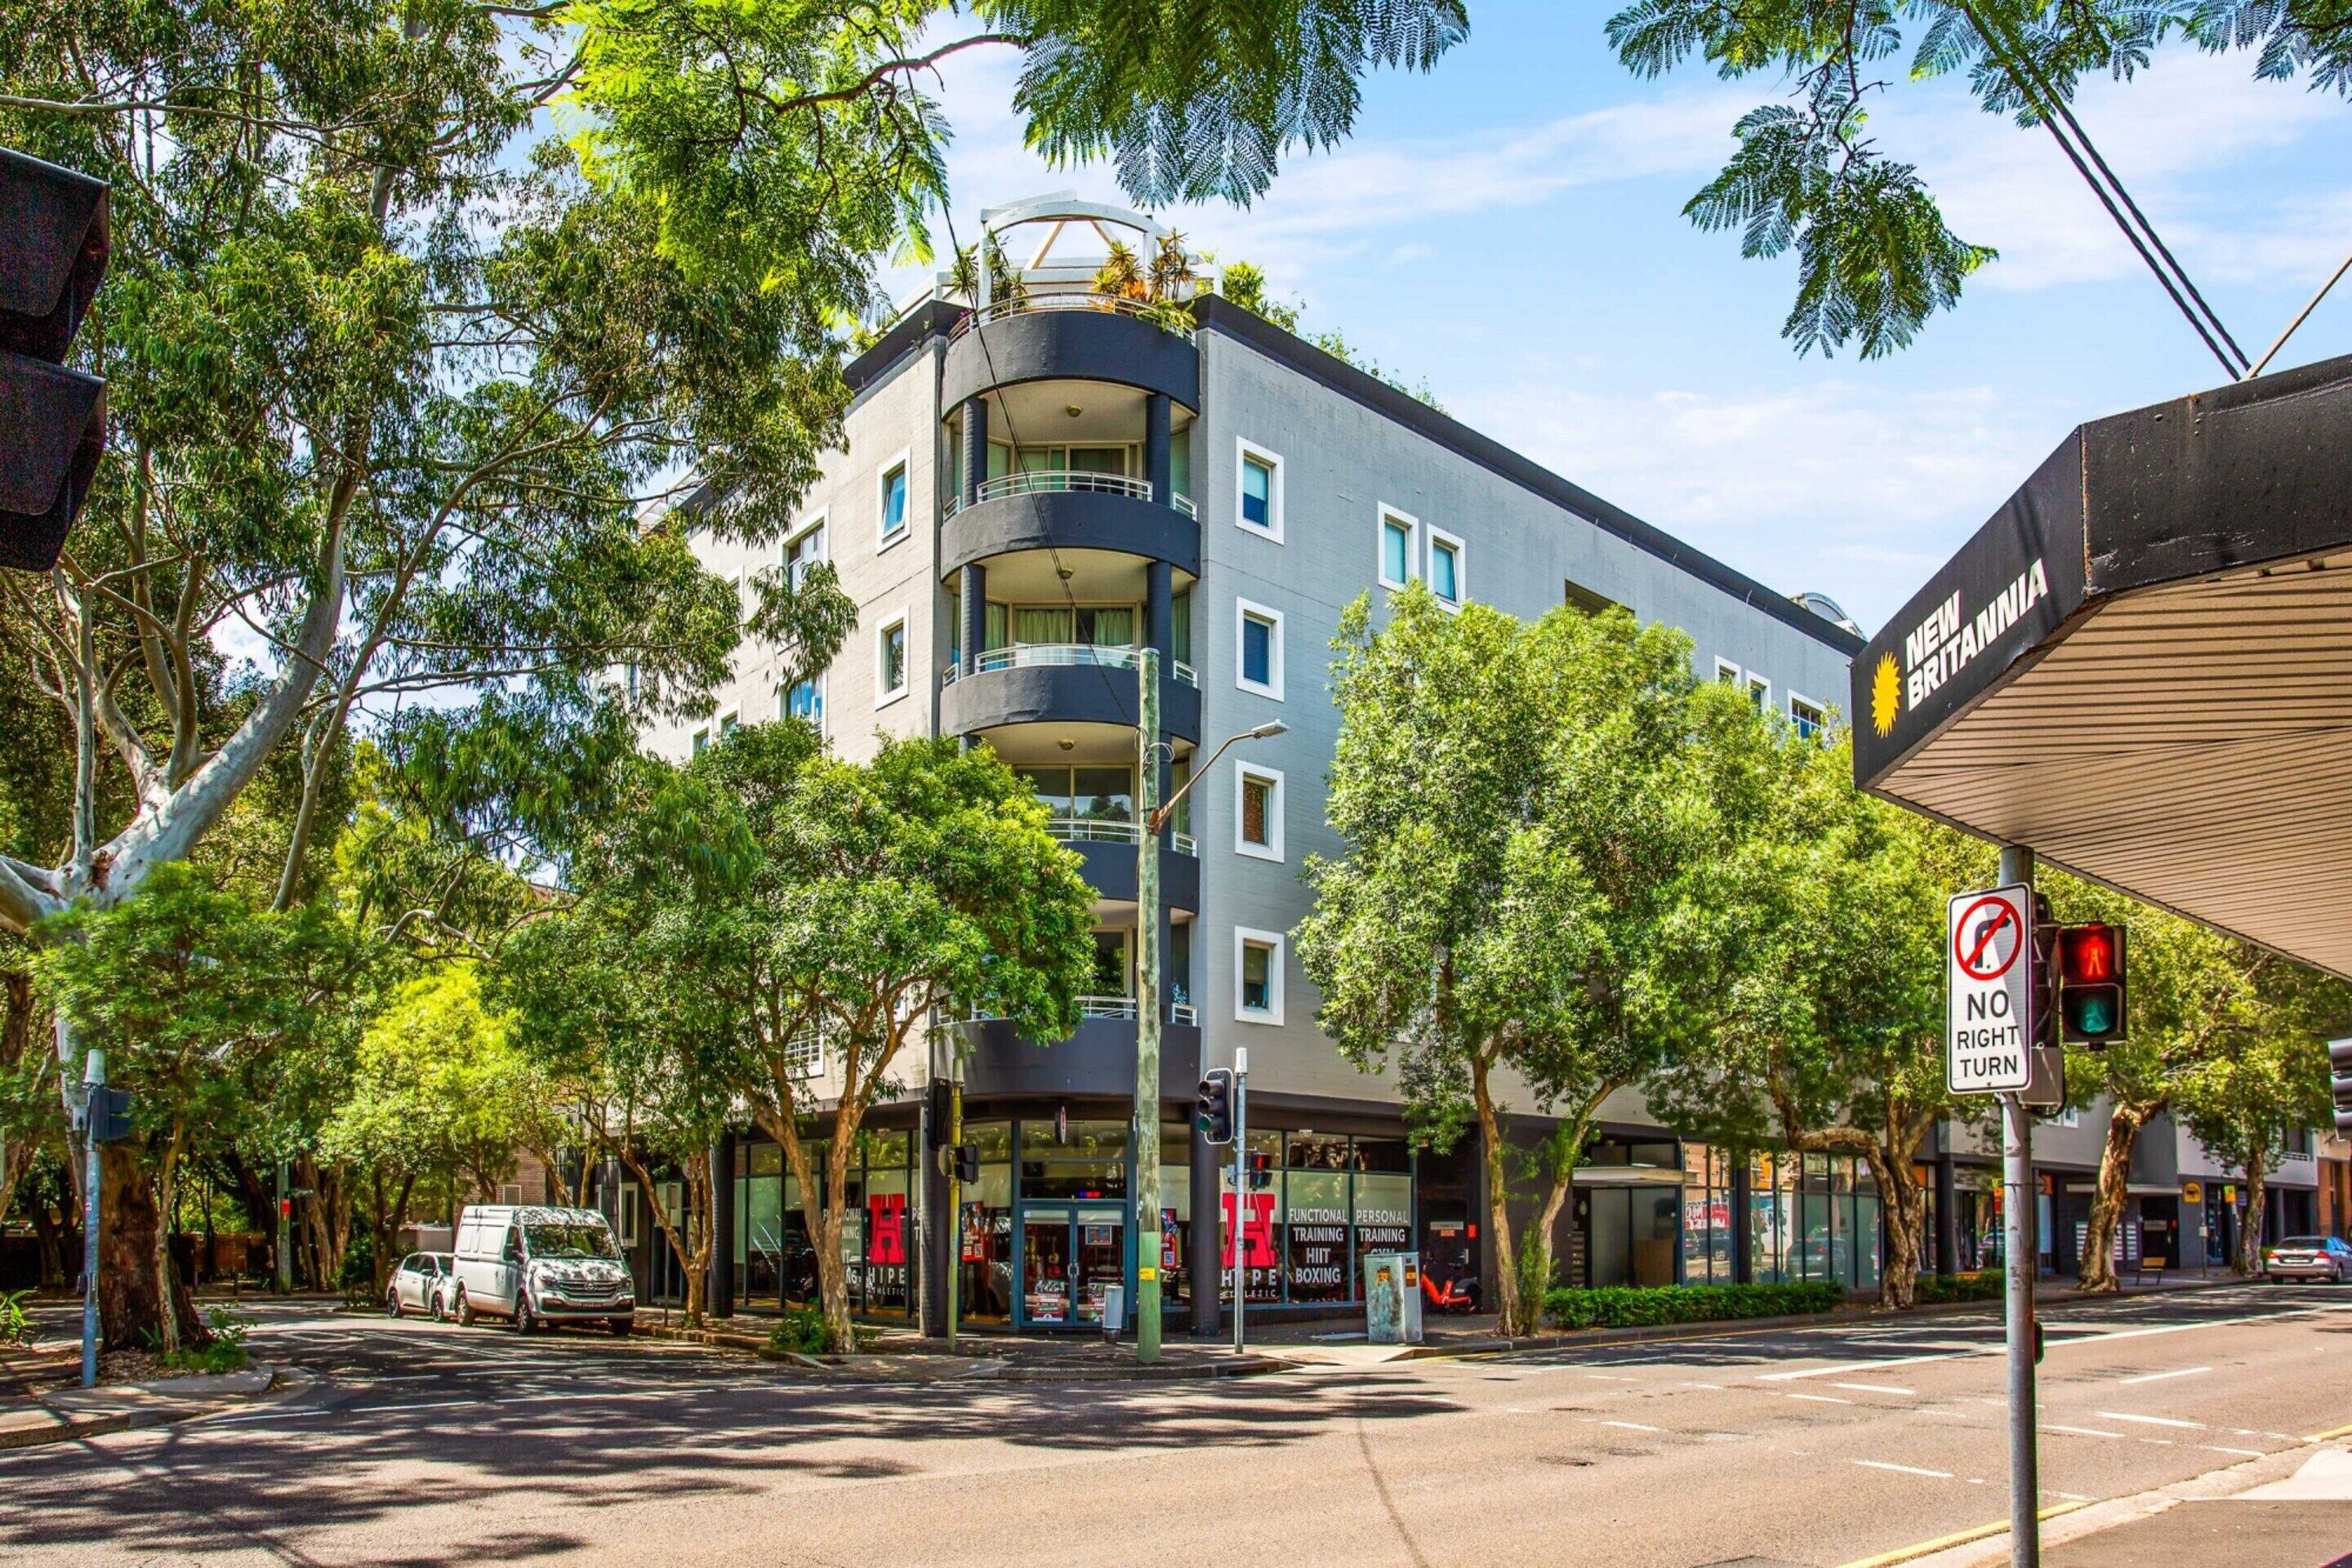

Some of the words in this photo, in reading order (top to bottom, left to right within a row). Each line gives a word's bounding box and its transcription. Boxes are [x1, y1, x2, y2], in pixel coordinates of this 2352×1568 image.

[1905, 590, 1961, 673] NEW
[1907, 557, 2049, 712] BRITANNIA
[1967, 989, 2009, 1022] NO
[1957, 1025, 2019, 1050] RIGHT
[1960, 1054, 2017, 1078] TURN
[822, 1207, 862, 1221] FONAL
[1288, 1208, 1348, 1223] FUNCTIONAL
[1356, 1209, 1409, 1223] PERSONAL
[1293, 1227, 1344, 1242] TRAINING
[1358, 1227, 1405, 1242] TRAINING
[1306, 1247, 1331, 1264] HIIT
[867, 1267, 905, 1285] HIPE
[1221, 1268, 1276, 1286] HPE
[1295, 1267, 1341, 1284] BOXING
[1221, 1290, 1276, 1298] TLETIC
